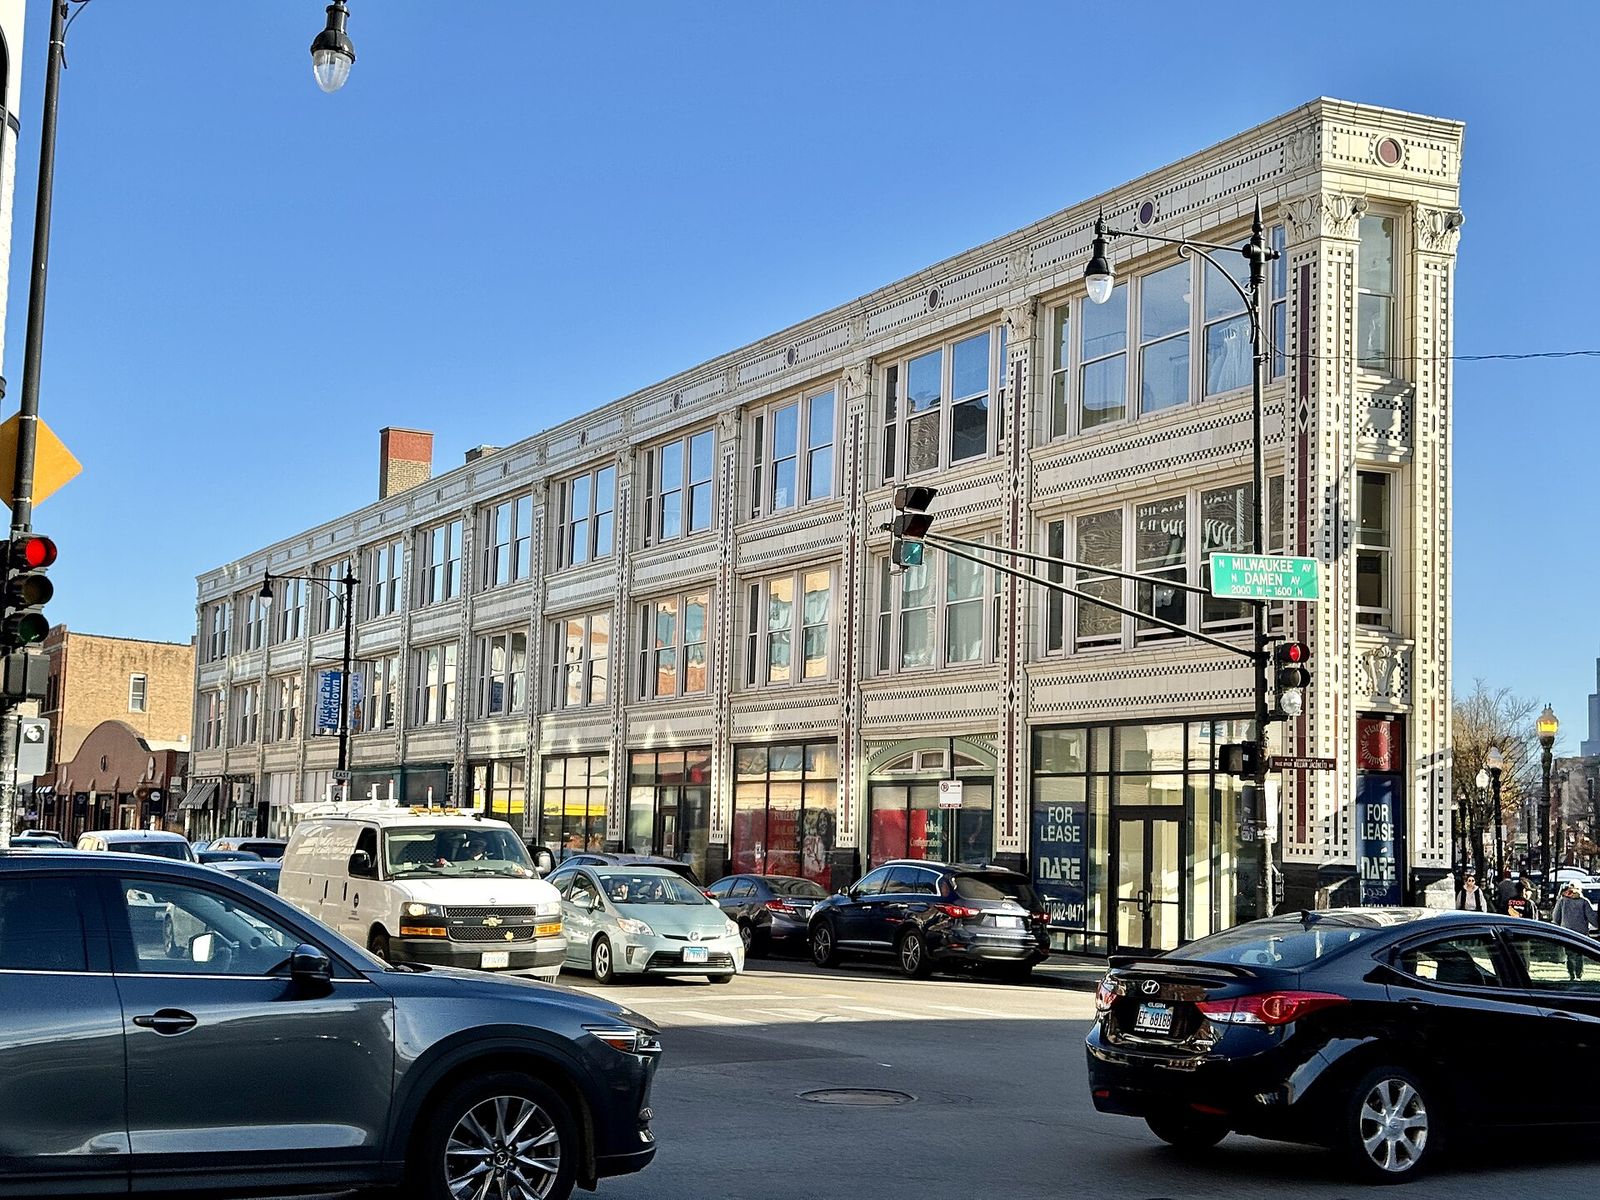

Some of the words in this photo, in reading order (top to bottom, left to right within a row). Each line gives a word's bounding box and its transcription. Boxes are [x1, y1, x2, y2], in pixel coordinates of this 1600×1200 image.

[1218, 559, 1225, 568] N
[1232, 557, 1294, 573] MILWAUKEE
[1301, 563, 1312, 572] AV
[1231, 574, 1238, 582] N
[1244, 572, 1283, 586] DAMEN
[1290, 576, 1301, 585] AV
[1231, 585, 1251, 594] 2000
[1256, 586, 1263, 594] W
[1274, 586, 1292, 596] 1600
[1297, 588, 1303, 597] N
[321, 673, 331, 692] Park
[327, 679, 340, 725] Bucktown
[319, 696, 330, 727] Wicker
[1047, 806, 1073, 823] FOR
[1367, 803, 1389, 822] FOR
[1040, 825, 1080, 842] LEASE
[1361, 823, 1395, 841] LEASE
